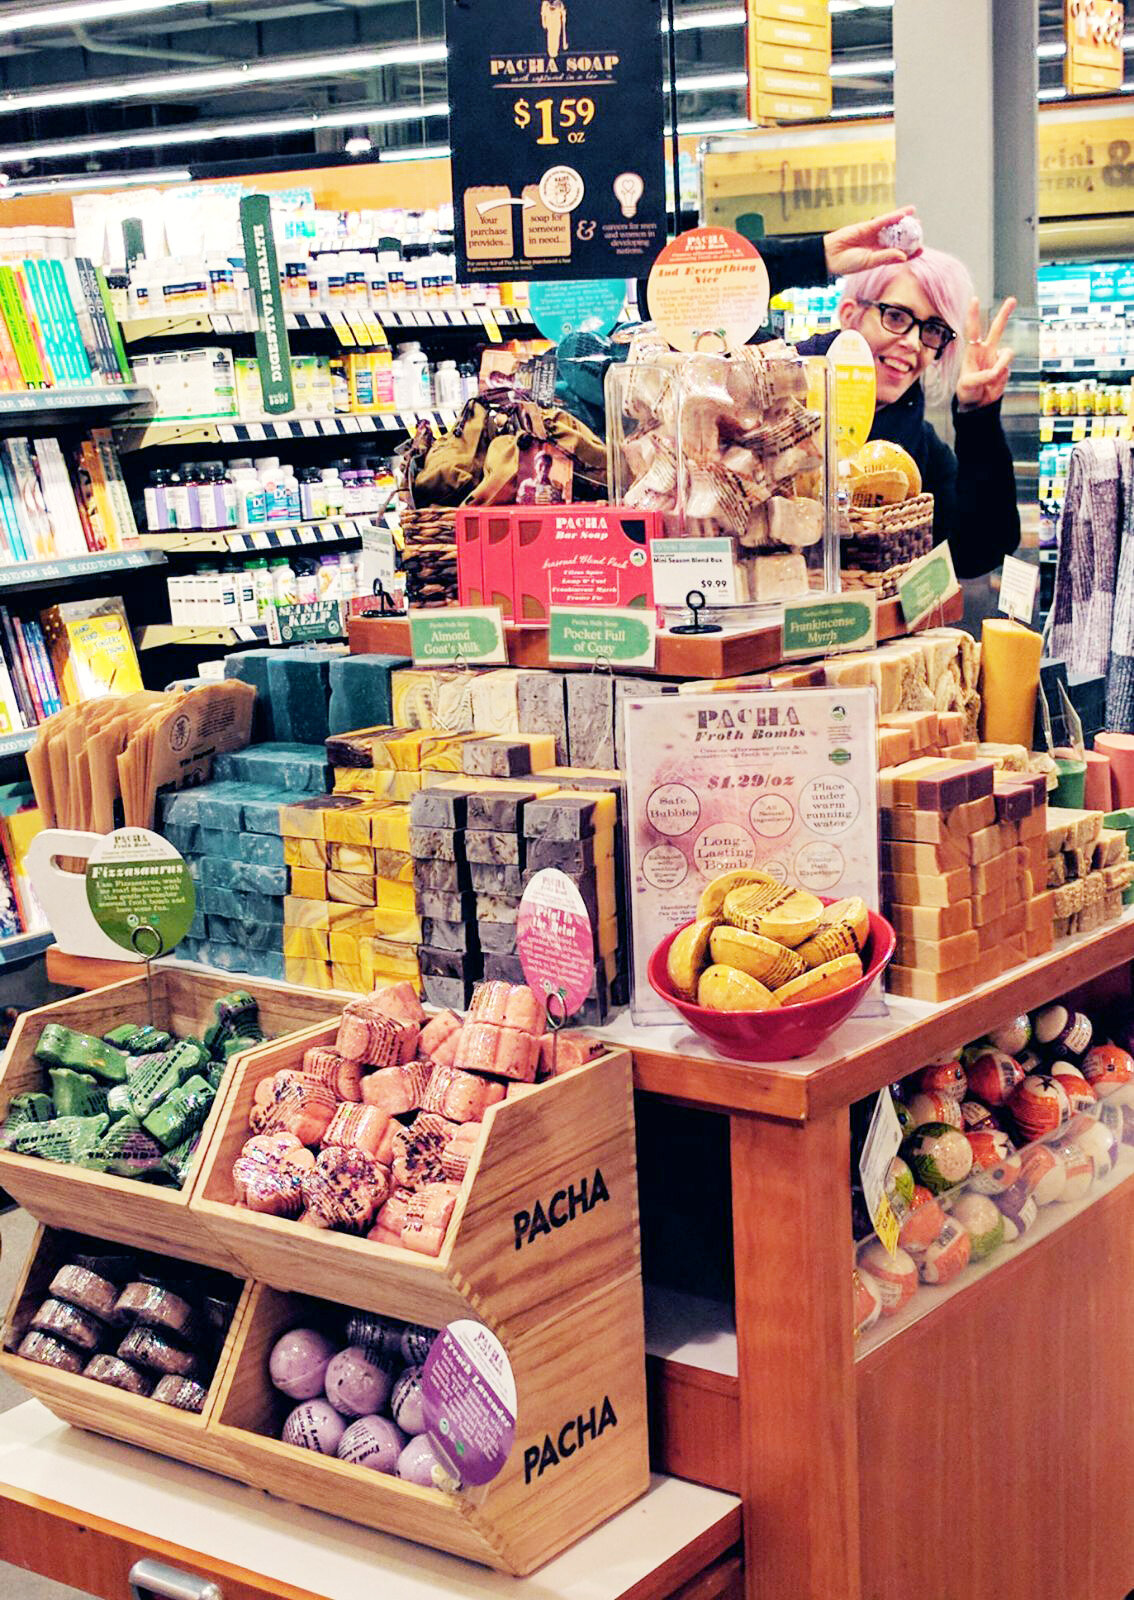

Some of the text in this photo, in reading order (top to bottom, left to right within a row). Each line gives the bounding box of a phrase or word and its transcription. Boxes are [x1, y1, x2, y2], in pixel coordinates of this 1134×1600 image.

[490, 55, 620, 75] PACHA SOAP
[480, 216, 497, 225] Your
[530, 213, 563, 223] soap for
[528, 226, 566, 234] someone
[576, 220, 597, 240] &
[602, 223, 628, 231] careers
[629, 222, 639, 230] for
[470, 228, 507, 238] purchase
[610, 239, 650, 248] developing
[687, 234, 727, 246] PACHA
[252, 223, 272, 291] HEALTH
[684, 264, 757, 276] Everything
[262, 293, 284, 383] DIGESTIVE
[555, 517, 608, 531] PACHA
[555, 530, 609, 541] Bar Soap
[579, 553, 607, 566] Blend
[701, 580, 727, 589] $9.99
[790, 616, 856, 633] Frankincense
[431, 629, 471, 643] Almond
[563, 627, 626, 642] Pocket Full
[807, 629, 838, 643] Myrrh
[423, 641, 481, 655] Goat's Milk
[573, 641, 617, 655] of Cozy
[698, 706, 800, 729] PACHA
[695, 728, 806, 743] Froth Bombs
[707, 774, 795, 789] $1.29/oz
[813, 782, 845, 791] Place
[659, 797, 687, 805] Safe
[811, 791, 846, 800] under
[650, 808, 698, 818] Bubbles
[806, 810, 852, 820] running
[812, 820, 847, 829] water
[114, 834, 148, 843] PACHA
[703, 837, 747, 847] Long-
[697, 848, 753, 860] Lasting
[91, 864, 184, 879] Fizzasaurus
[704, 860, 748, 871] Bomb
[514, 1167, 611, 1251] PACHA
[442, 1333, 473, 1376] French
[471, 1374, 513, 1429] Lavender
[524, 1394, 618, 1485] PACHA
